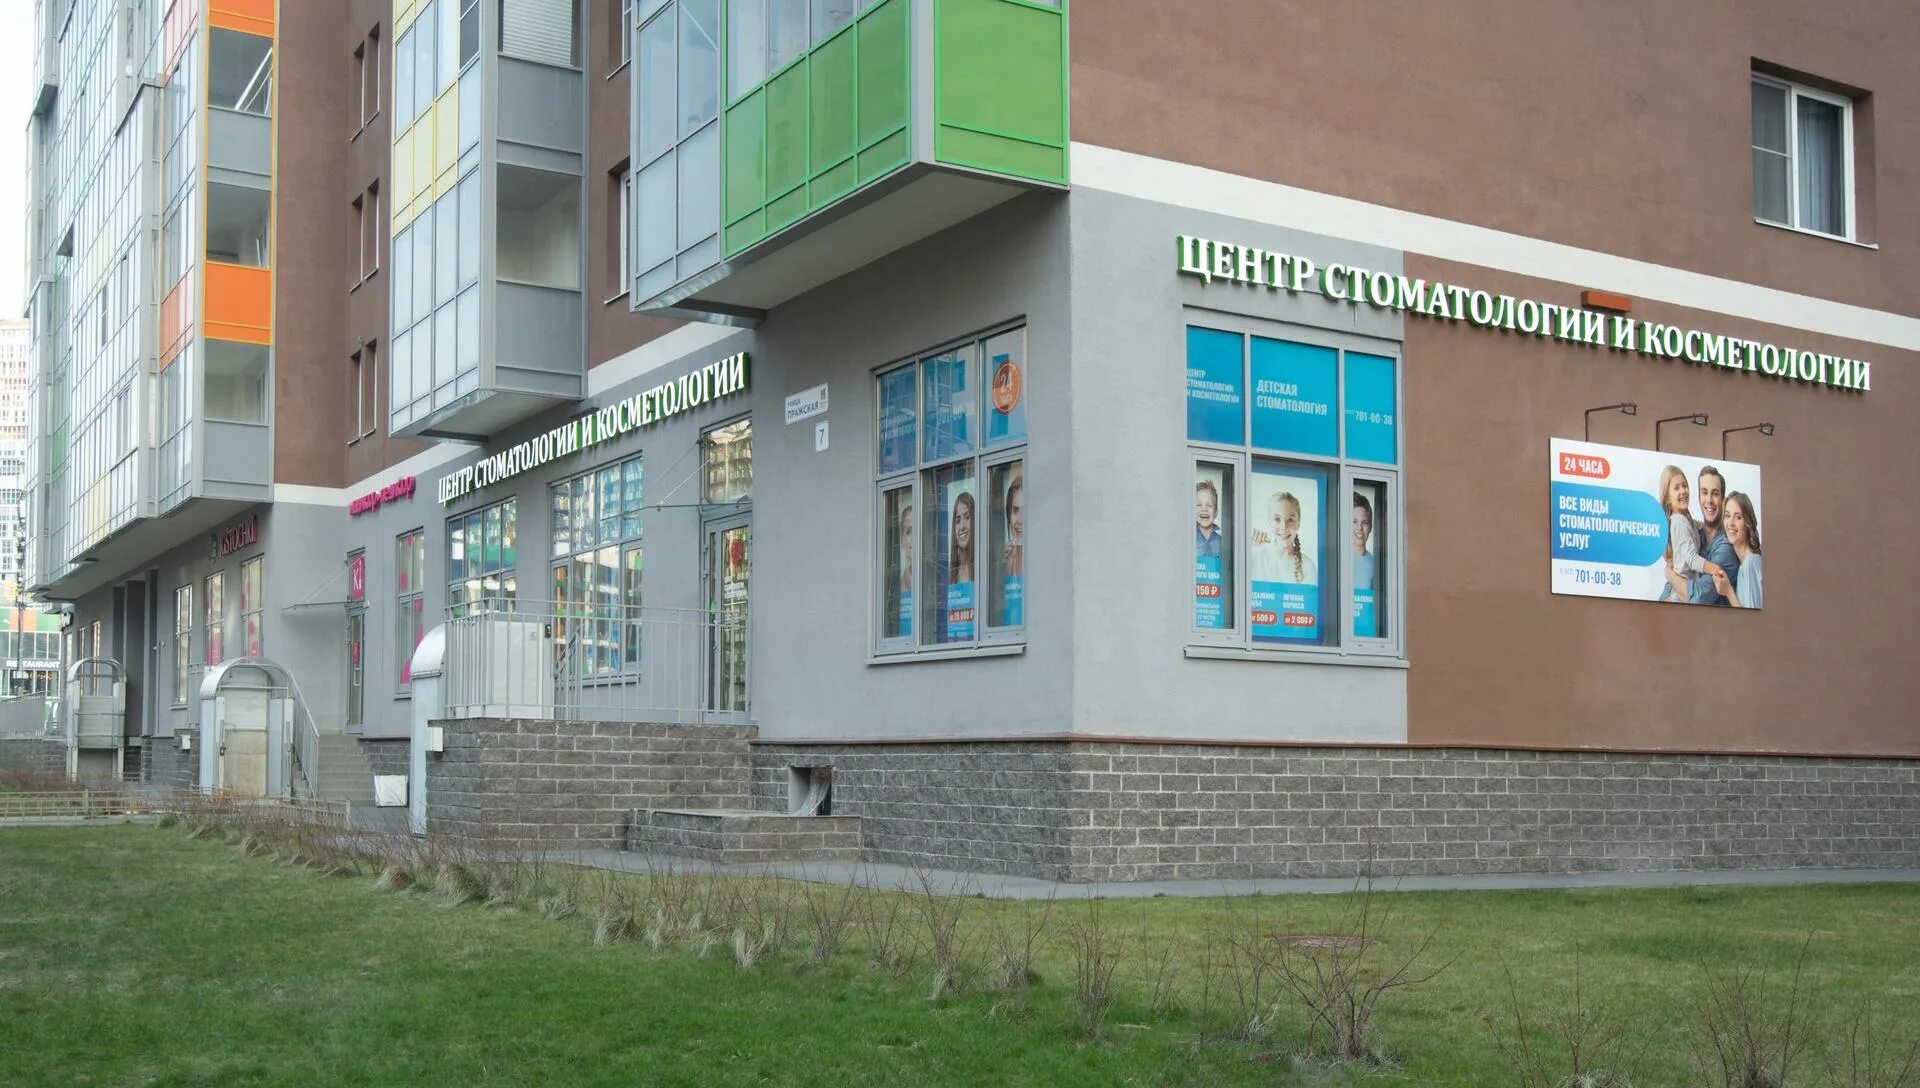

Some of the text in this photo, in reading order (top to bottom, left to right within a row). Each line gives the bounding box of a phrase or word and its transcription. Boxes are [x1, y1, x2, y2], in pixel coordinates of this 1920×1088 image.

[1177, 235, 1872, 392] ЦЕНТР СТОМАТОЛОГИИ И КОСМЕТОЛОГИИ
[1000, 371, 1013, 393] 24
[1256, 378, 1298, 396] ДЕТСКАЯ
[1192, 389, 1239, 404] КОСМЕТОЛОГИИ
[788, 401, 819, 420] ПРАЖСКАЯ
[1256, 395, 1328, 417] СТОМАТОЛОГИЯ
[1355, 410, 1393, 426] 701-00-38
[438, 351, 747, 508] ЦЕНТР СТОМАТОЛОГИИ И КОСМЕТОЛОГИИ
[819, 428, 825, 445] 7
[1564, 457, 1604, 475] 24 ЧАСА
[1559, 495, 1609, 516] ВСЕ ВИДЫ
[1559, 514, 1661, 538] СТОМАТОЛОГИЧЕСКИХ
[1559, 533, 1591, 551] УСЛУГ
[1575, 569, 1622, 586] 701-00-38
[1252, 592, 1276, 600] ДАЛЕНИЕ
[6, 660, 61, 668] RETAURANT
